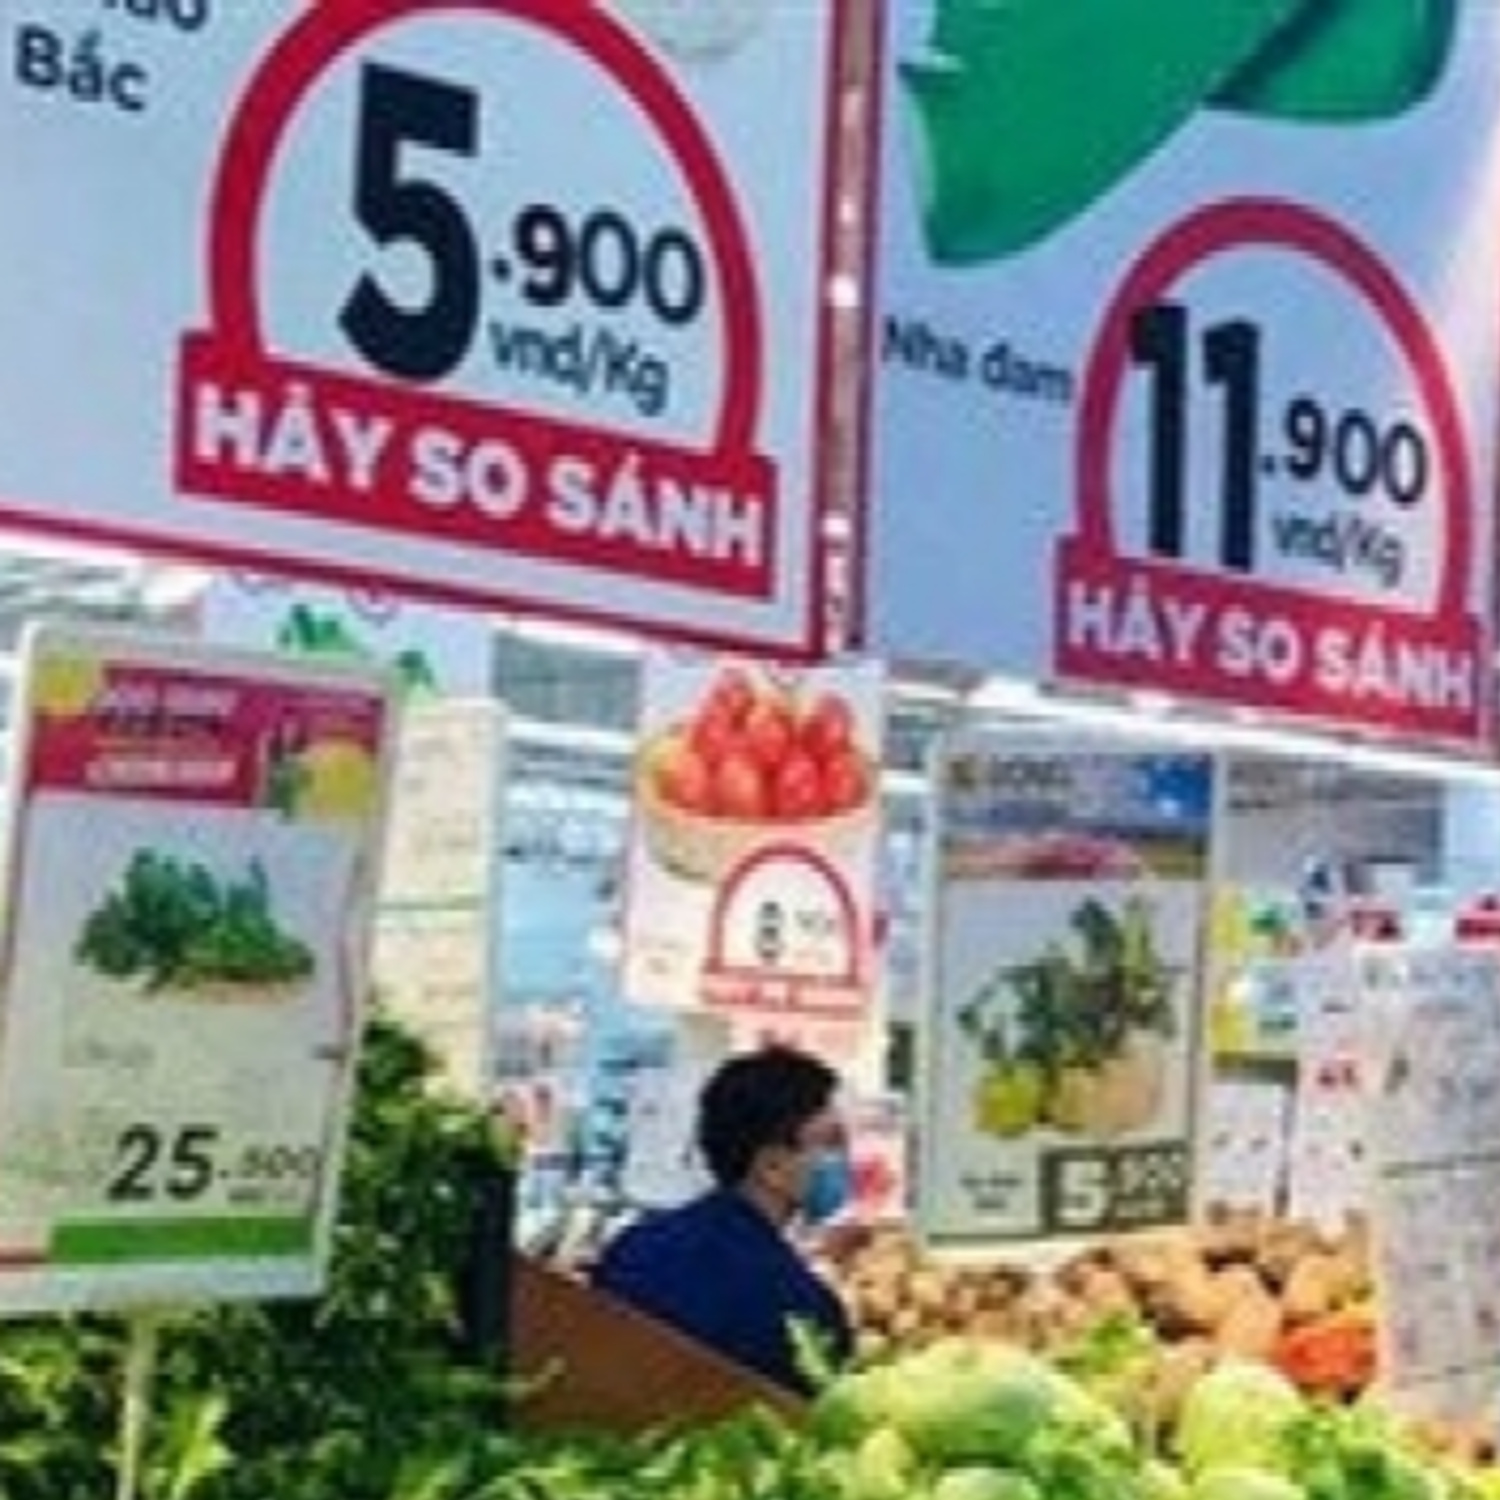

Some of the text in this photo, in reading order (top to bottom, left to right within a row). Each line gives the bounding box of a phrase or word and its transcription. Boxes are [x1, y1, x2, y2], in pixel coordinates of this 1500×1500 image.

[882, 315, 968, 382] Nha
[408, 428, 528, 519] SO
[547, 454, 763, 566] SÁNH
[1216, 607, 1302, 685] SO
